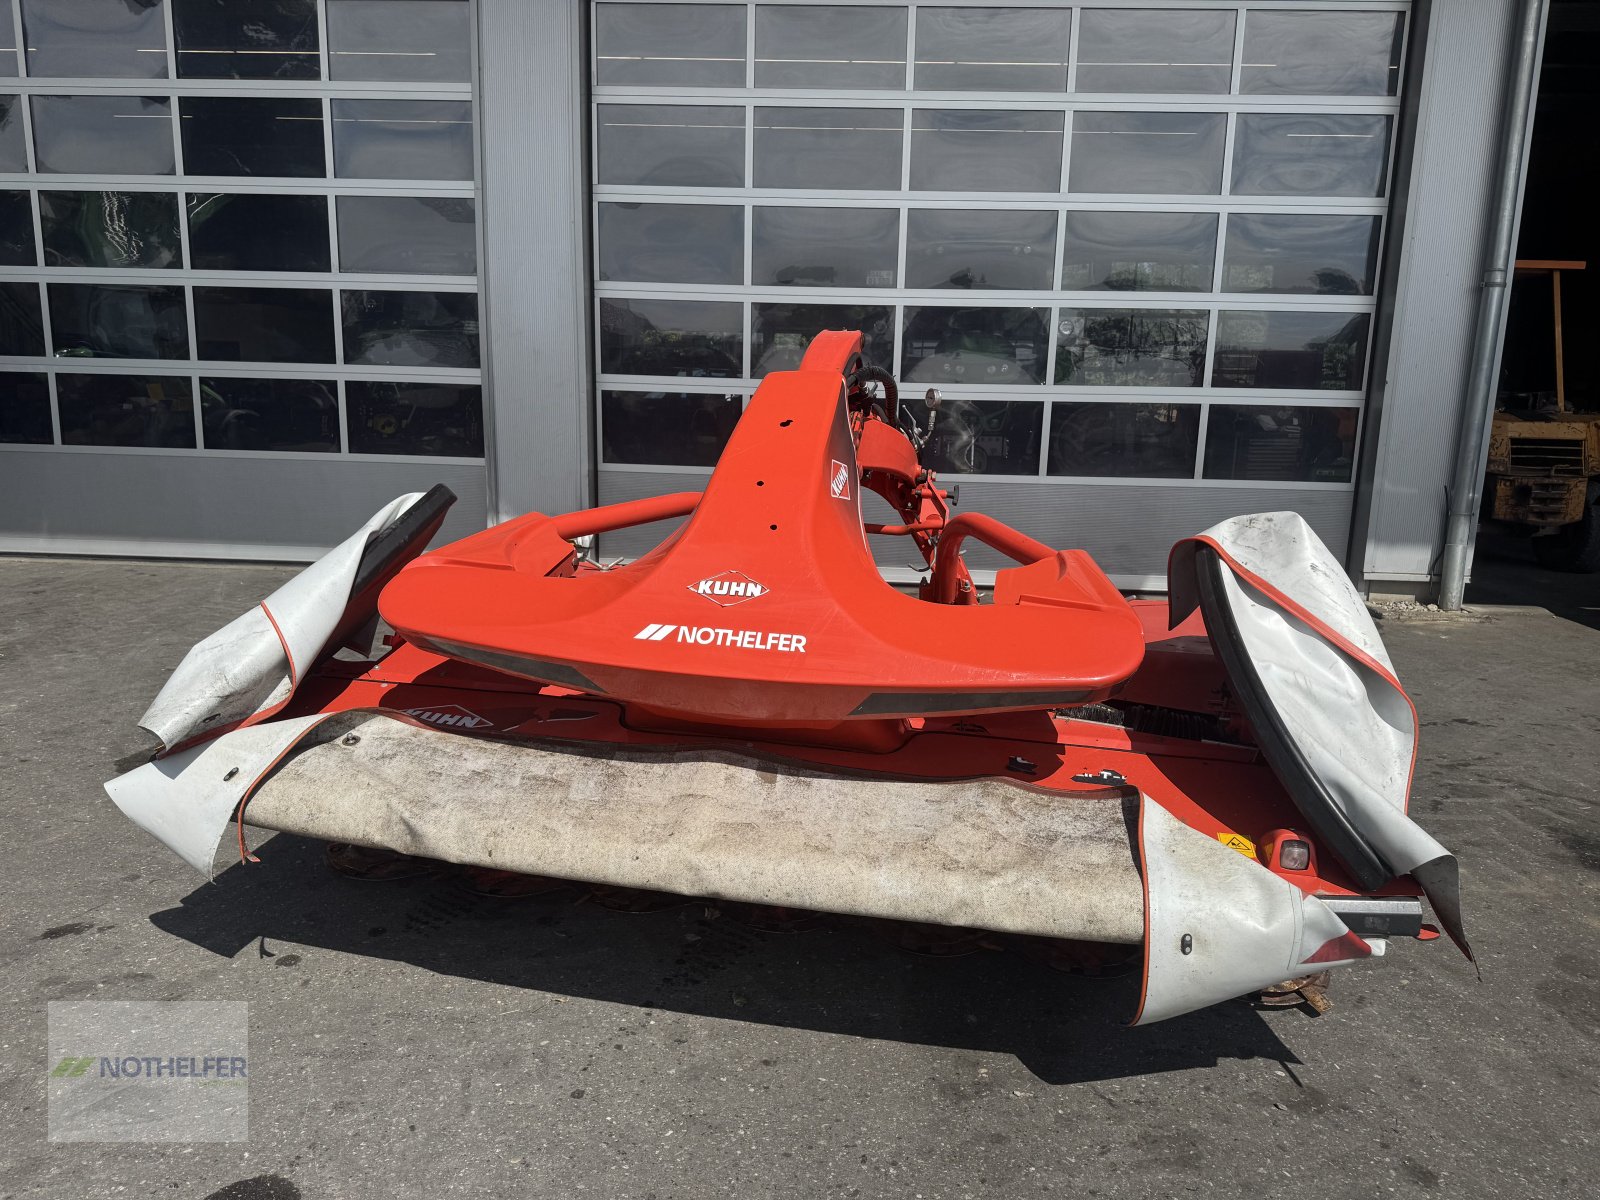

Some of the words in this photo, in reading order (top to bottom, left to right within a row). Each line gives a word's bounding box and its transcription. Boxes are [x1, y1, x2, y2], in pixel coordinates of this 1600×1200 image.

[832, 464, 848, 497] KUHN
[698, 580, 762, 597] KUHN
[677, 625, 807, 653] NOTHELFER
